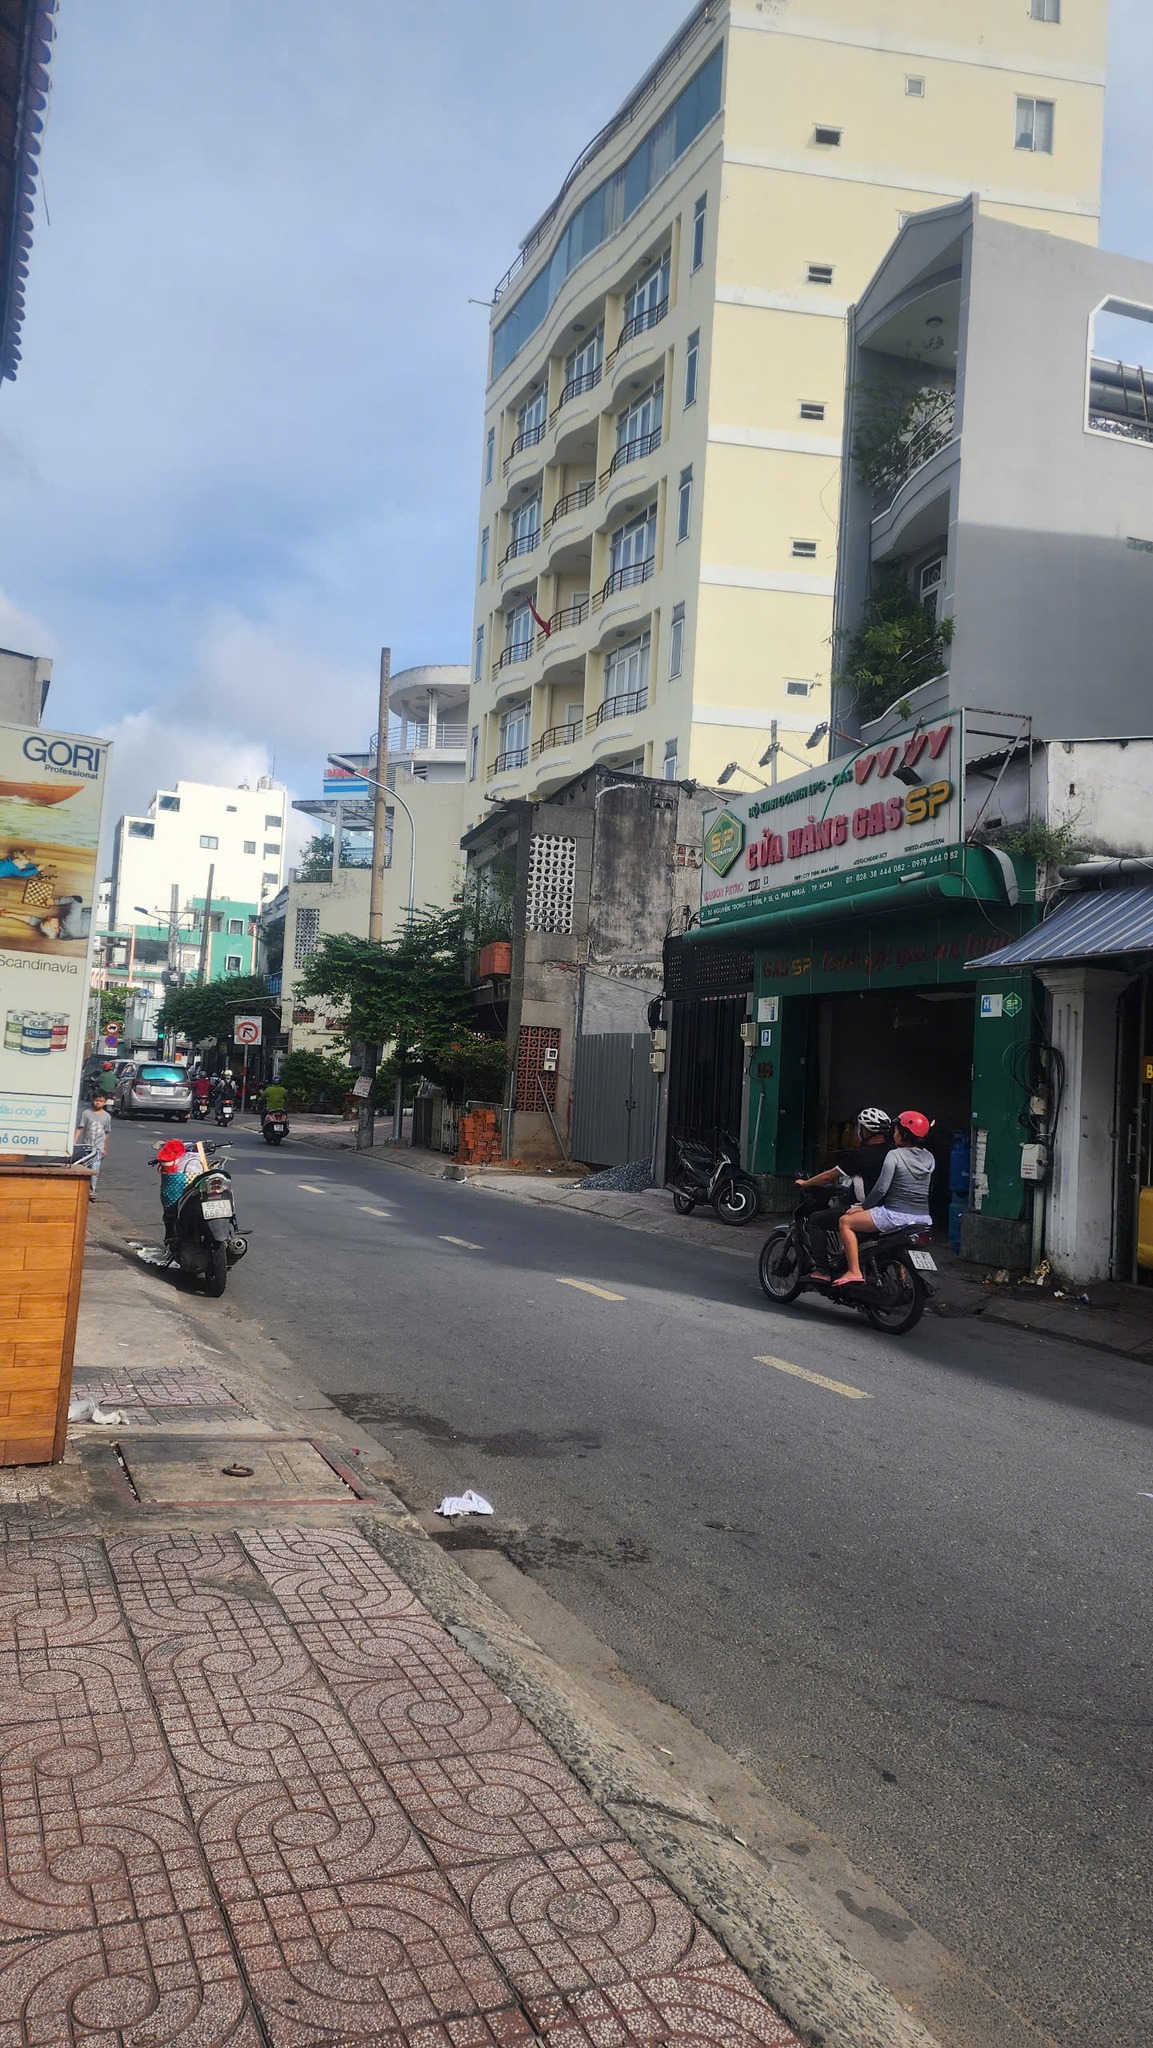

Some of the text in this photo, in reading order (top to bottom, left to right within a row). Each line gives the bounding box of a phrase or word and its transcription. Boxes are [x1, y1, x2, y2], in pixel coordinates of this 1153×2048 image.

[23, 736, 100, 772] GORI
[855, 745, 898, 785] VY
[44, 764, 98, 780] Professional
[745, 780, 952, 871] CỬA HÀNG GAS SP
[929, 856, 942, 864] 444
[12, 1135, 39, 1145] GORI
